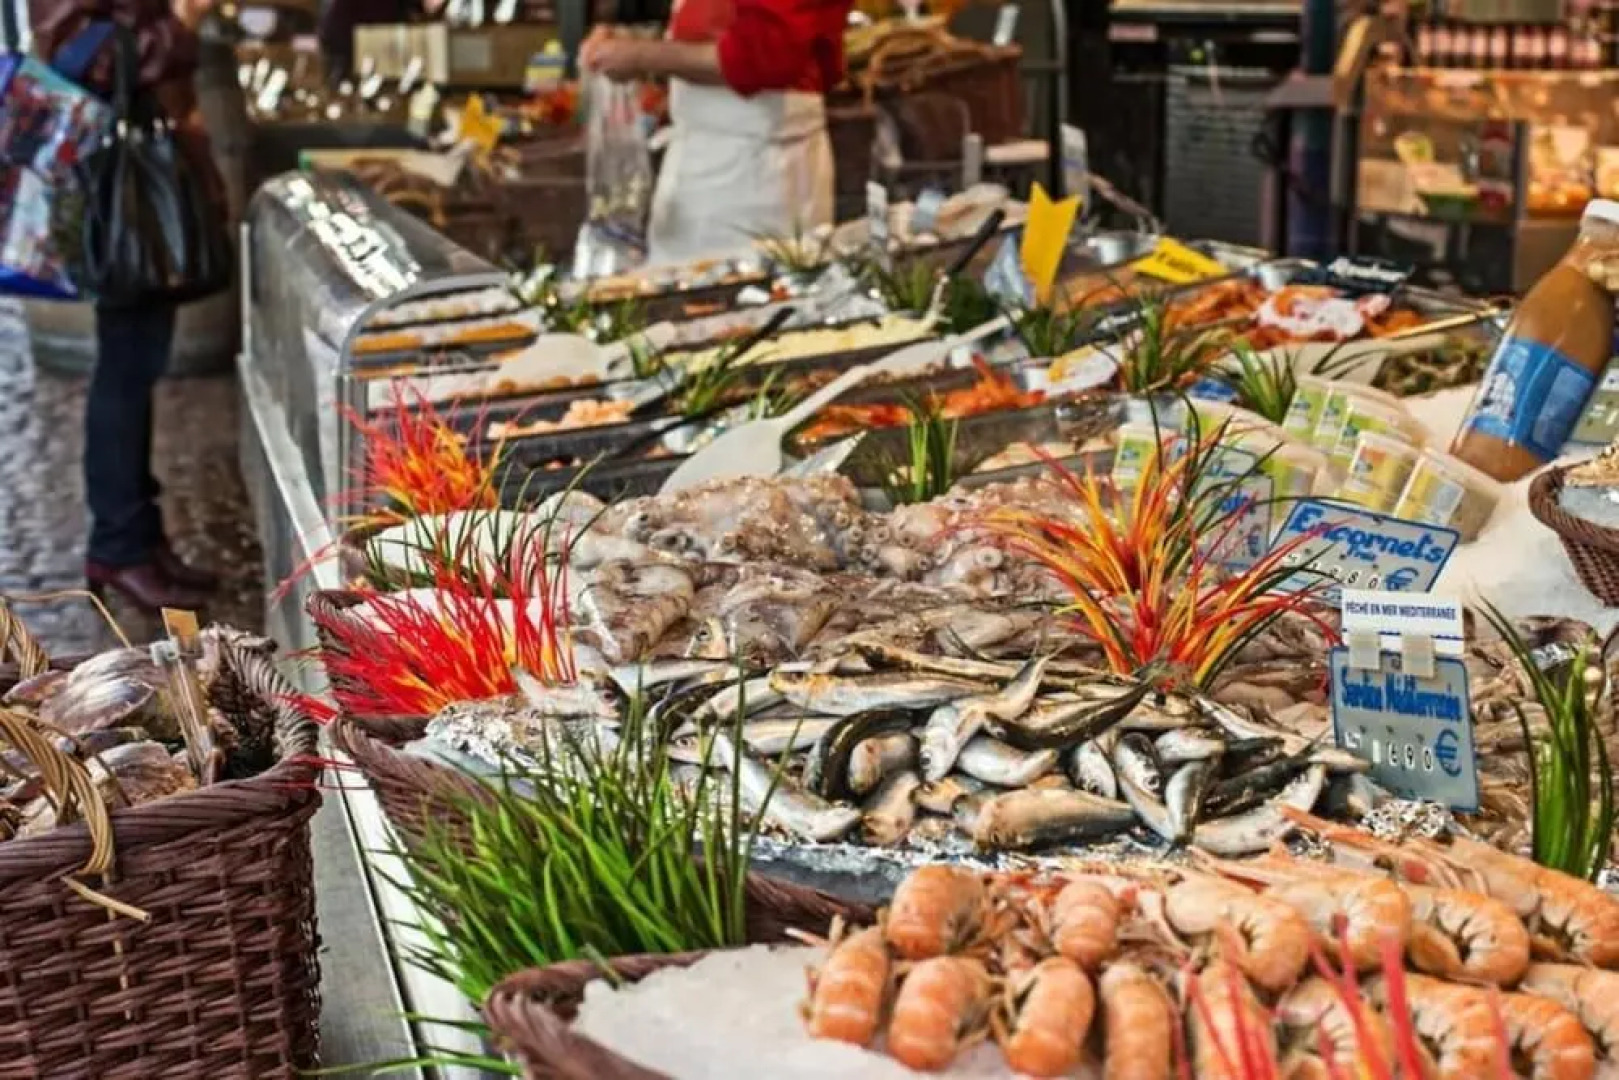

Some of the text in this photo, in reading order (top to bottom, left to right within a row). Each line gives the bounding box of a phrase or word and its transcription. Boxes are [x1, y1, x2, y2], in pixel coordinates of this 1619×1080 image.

[1288, 505, 1445, 563] Encornets
[1370, 603, 1380, 615] EN
[1381, 603, 1398, 617] MER
